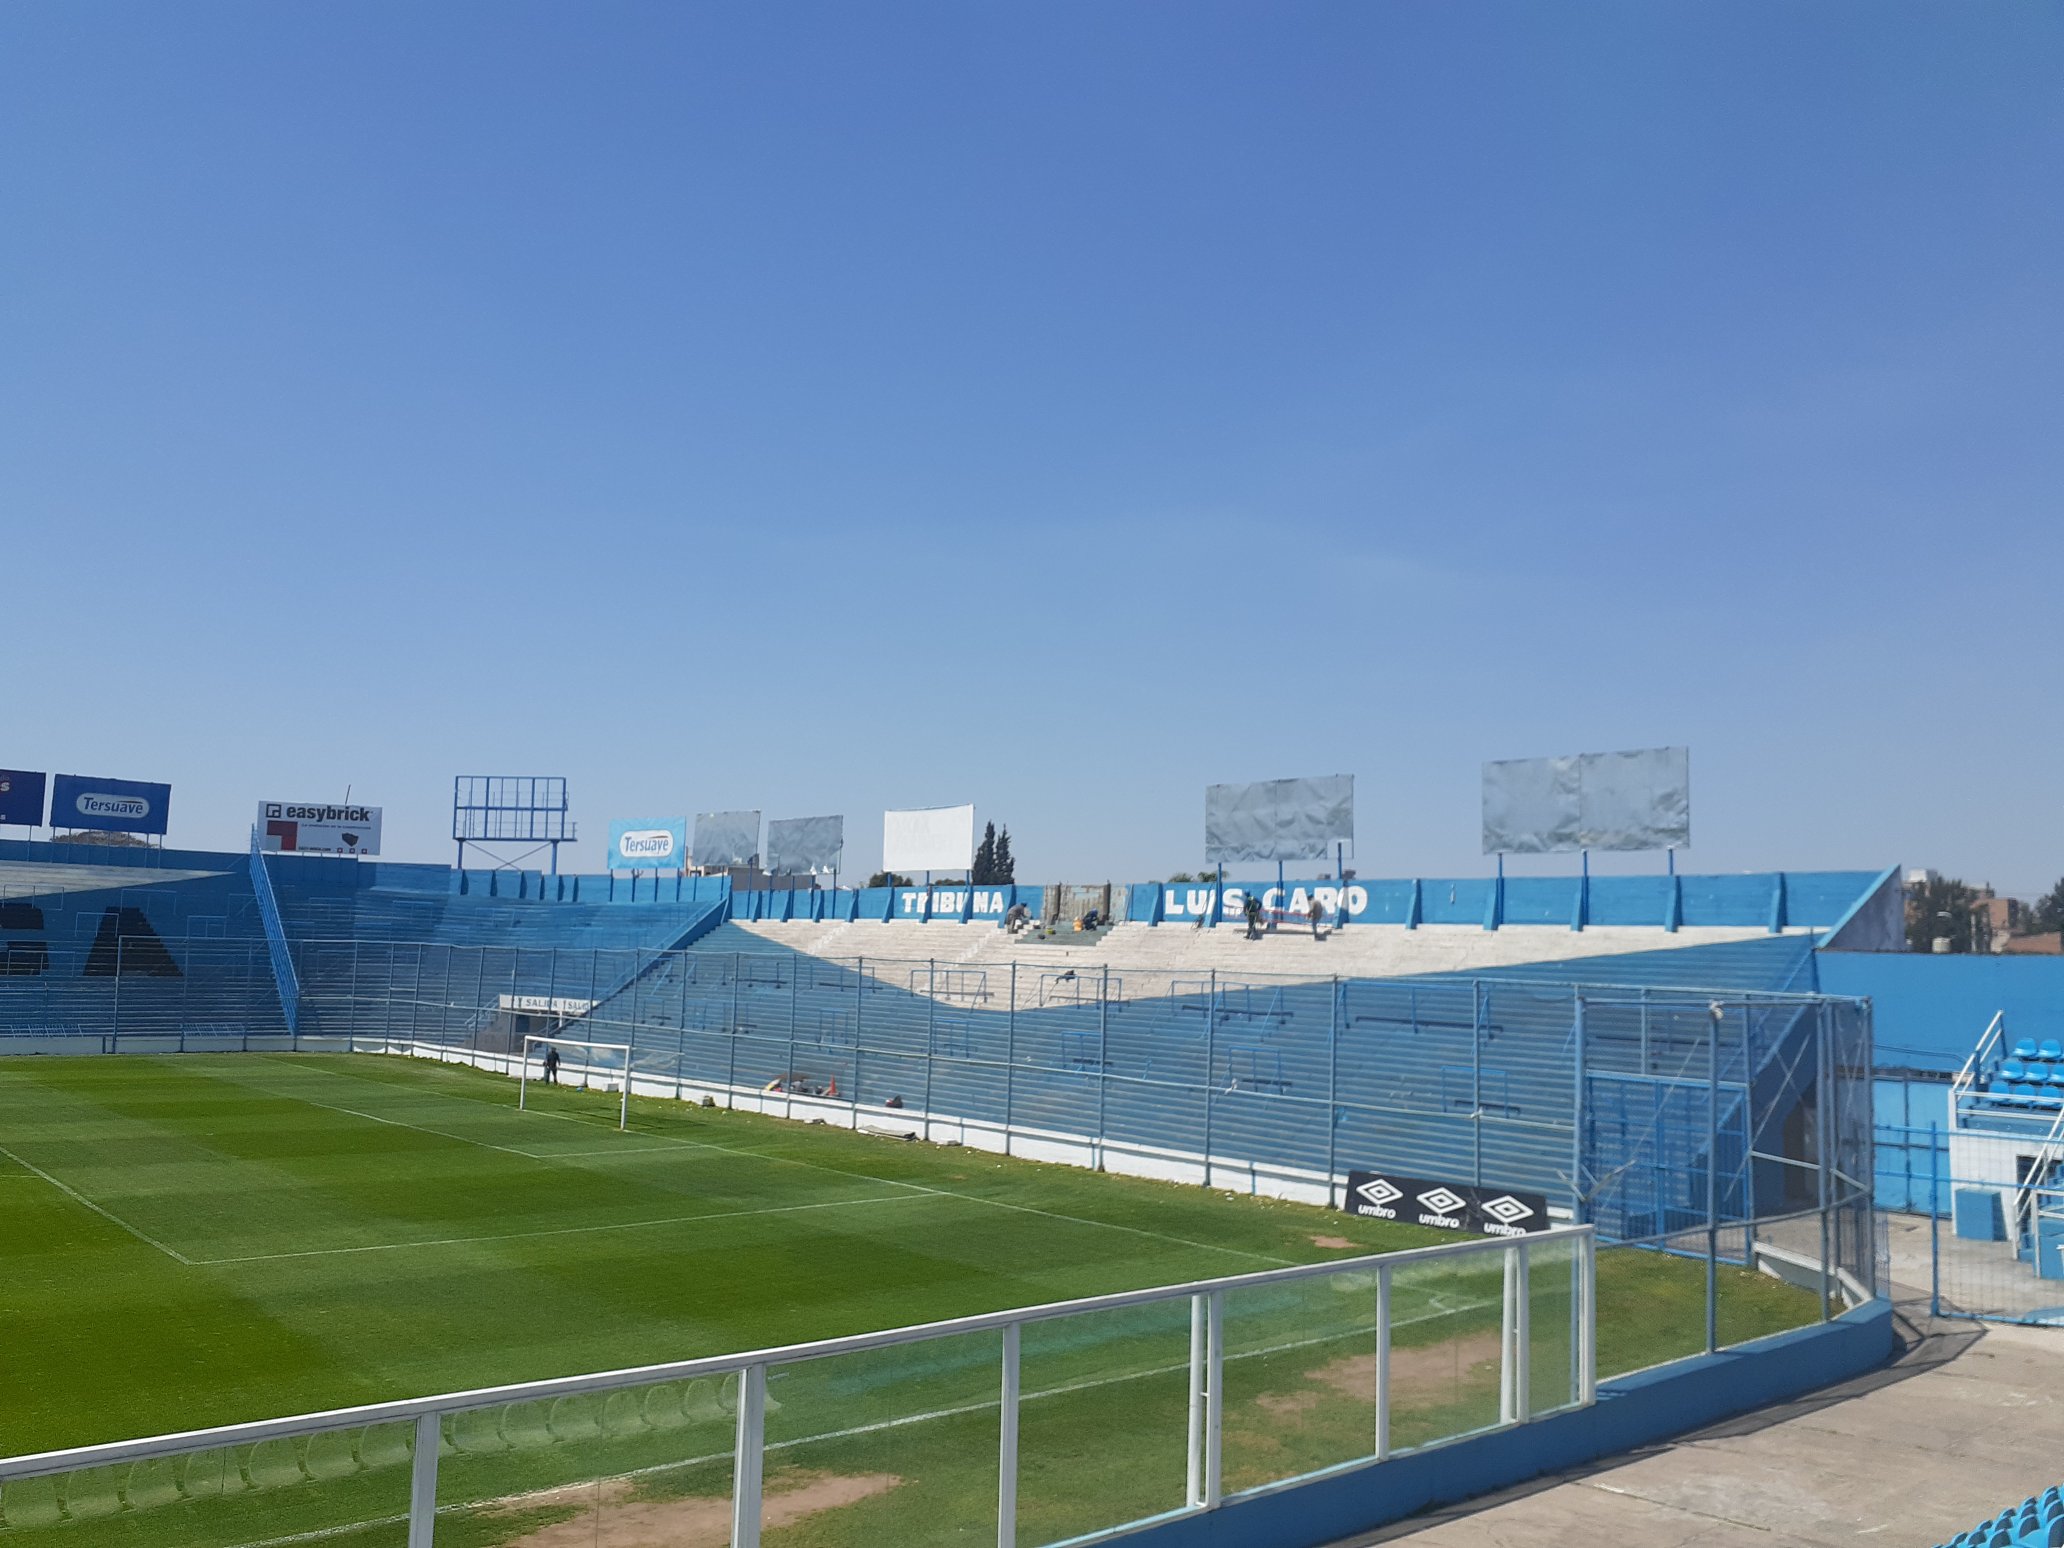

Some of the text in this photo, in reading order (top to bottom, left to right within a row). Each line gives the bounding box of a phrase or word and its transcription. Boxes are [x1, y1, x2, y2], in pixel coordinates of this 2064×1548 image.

[83, 797, 143, 814] Tersuave
[286, 805, 370, 822] easybrick
[624, 836, 669, 853] Tersuave
[1164, 888, 1245, 916] LUIS
[1357, 1204, 1397, 1219] umbro
[1418, 1212, 1460, 1229] umbro
[1483, 1222, 1528, 1237] umbro
